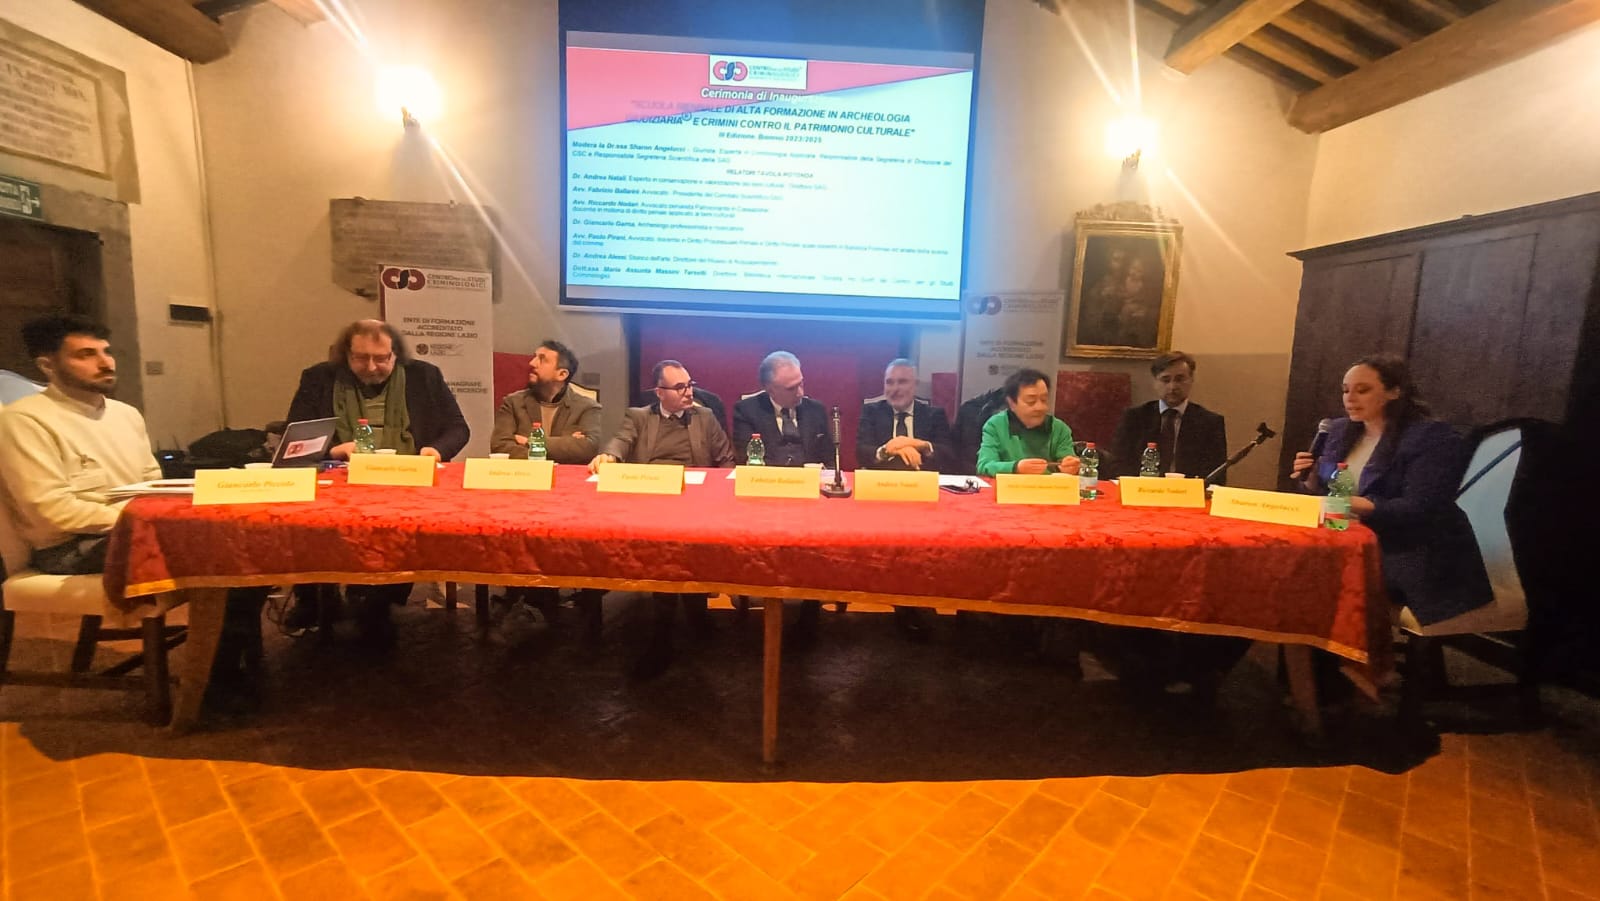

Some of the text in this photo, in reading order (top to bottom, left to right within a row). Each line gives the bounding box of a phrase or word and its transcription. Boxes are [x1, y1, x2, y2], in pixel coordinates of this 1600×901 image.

[701, 87, 753, 100] Cerimonia
[756, 92, 767, 101] di
[725, 105, 735, 114] DI
[737, 105, 761, 115] ALTA
[763, 106, 825, 118] FORMAZIONE
[828, 109, 838, 119] IN
[840, 111, 911, 123] ARCHEOLOGIA
[701, 118, 738, 128] CRIMINI
[740, 120, 782, 130] CONTRO
[784, 122, 792, 130] IL
[794, 122, 854, 134] PATRIMONIO
